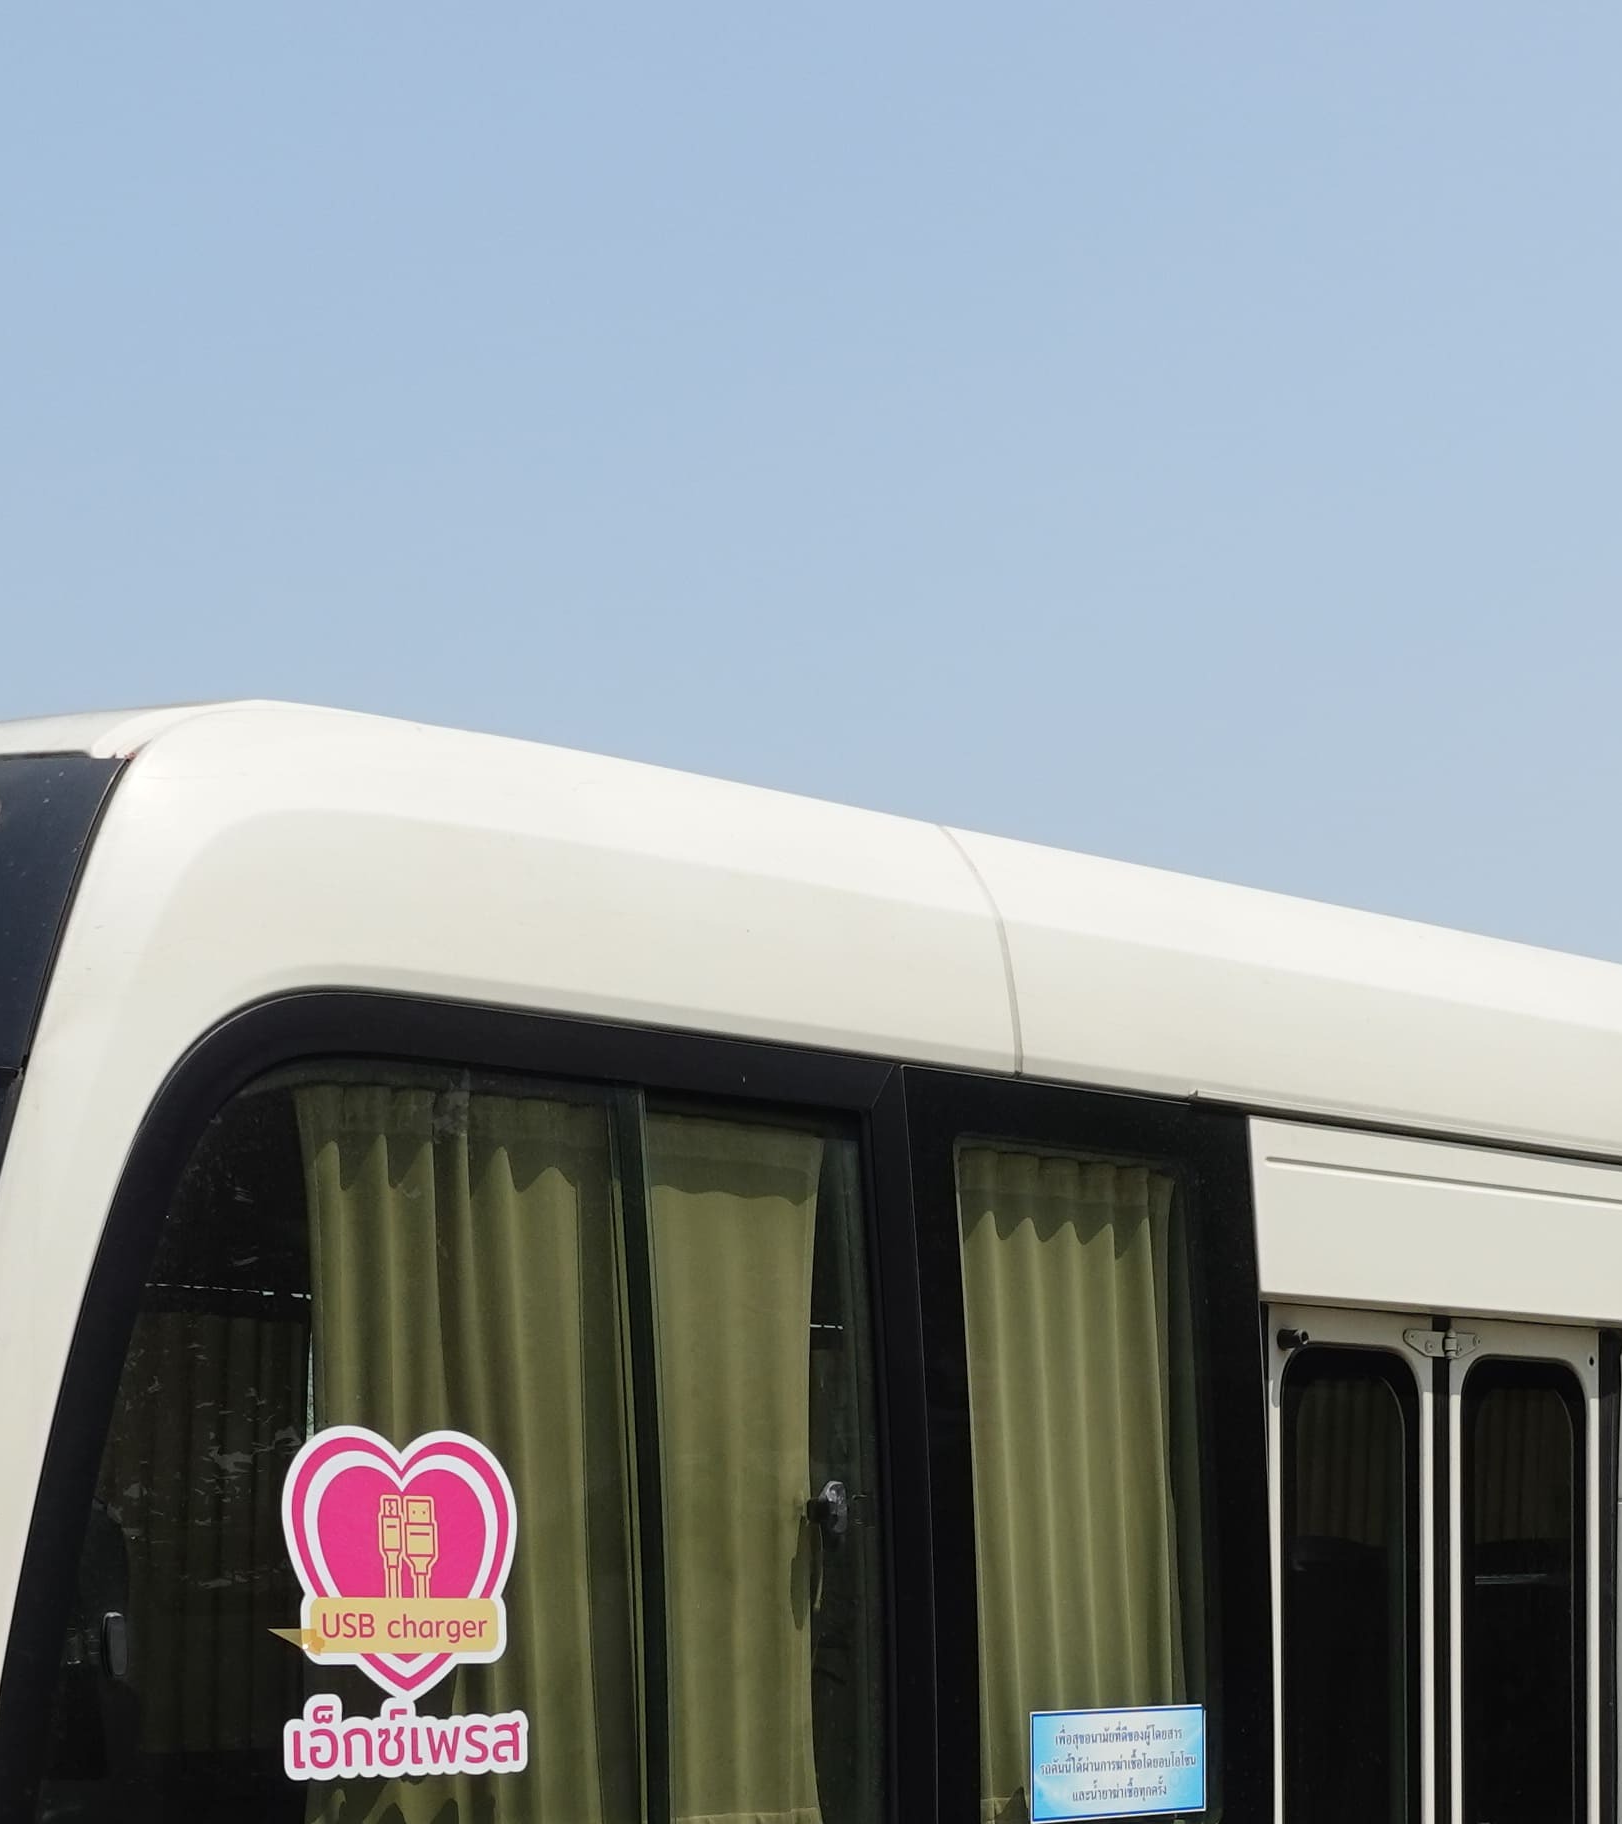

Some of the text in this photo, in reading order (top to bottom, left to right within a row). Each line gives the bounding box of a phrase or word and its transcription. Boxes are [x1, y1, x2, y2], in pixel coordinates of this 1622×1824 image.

[321, 1611, 489, 1644] USB charger
[291, 1704, 522, 1770] เอ็กซ์เพรส
